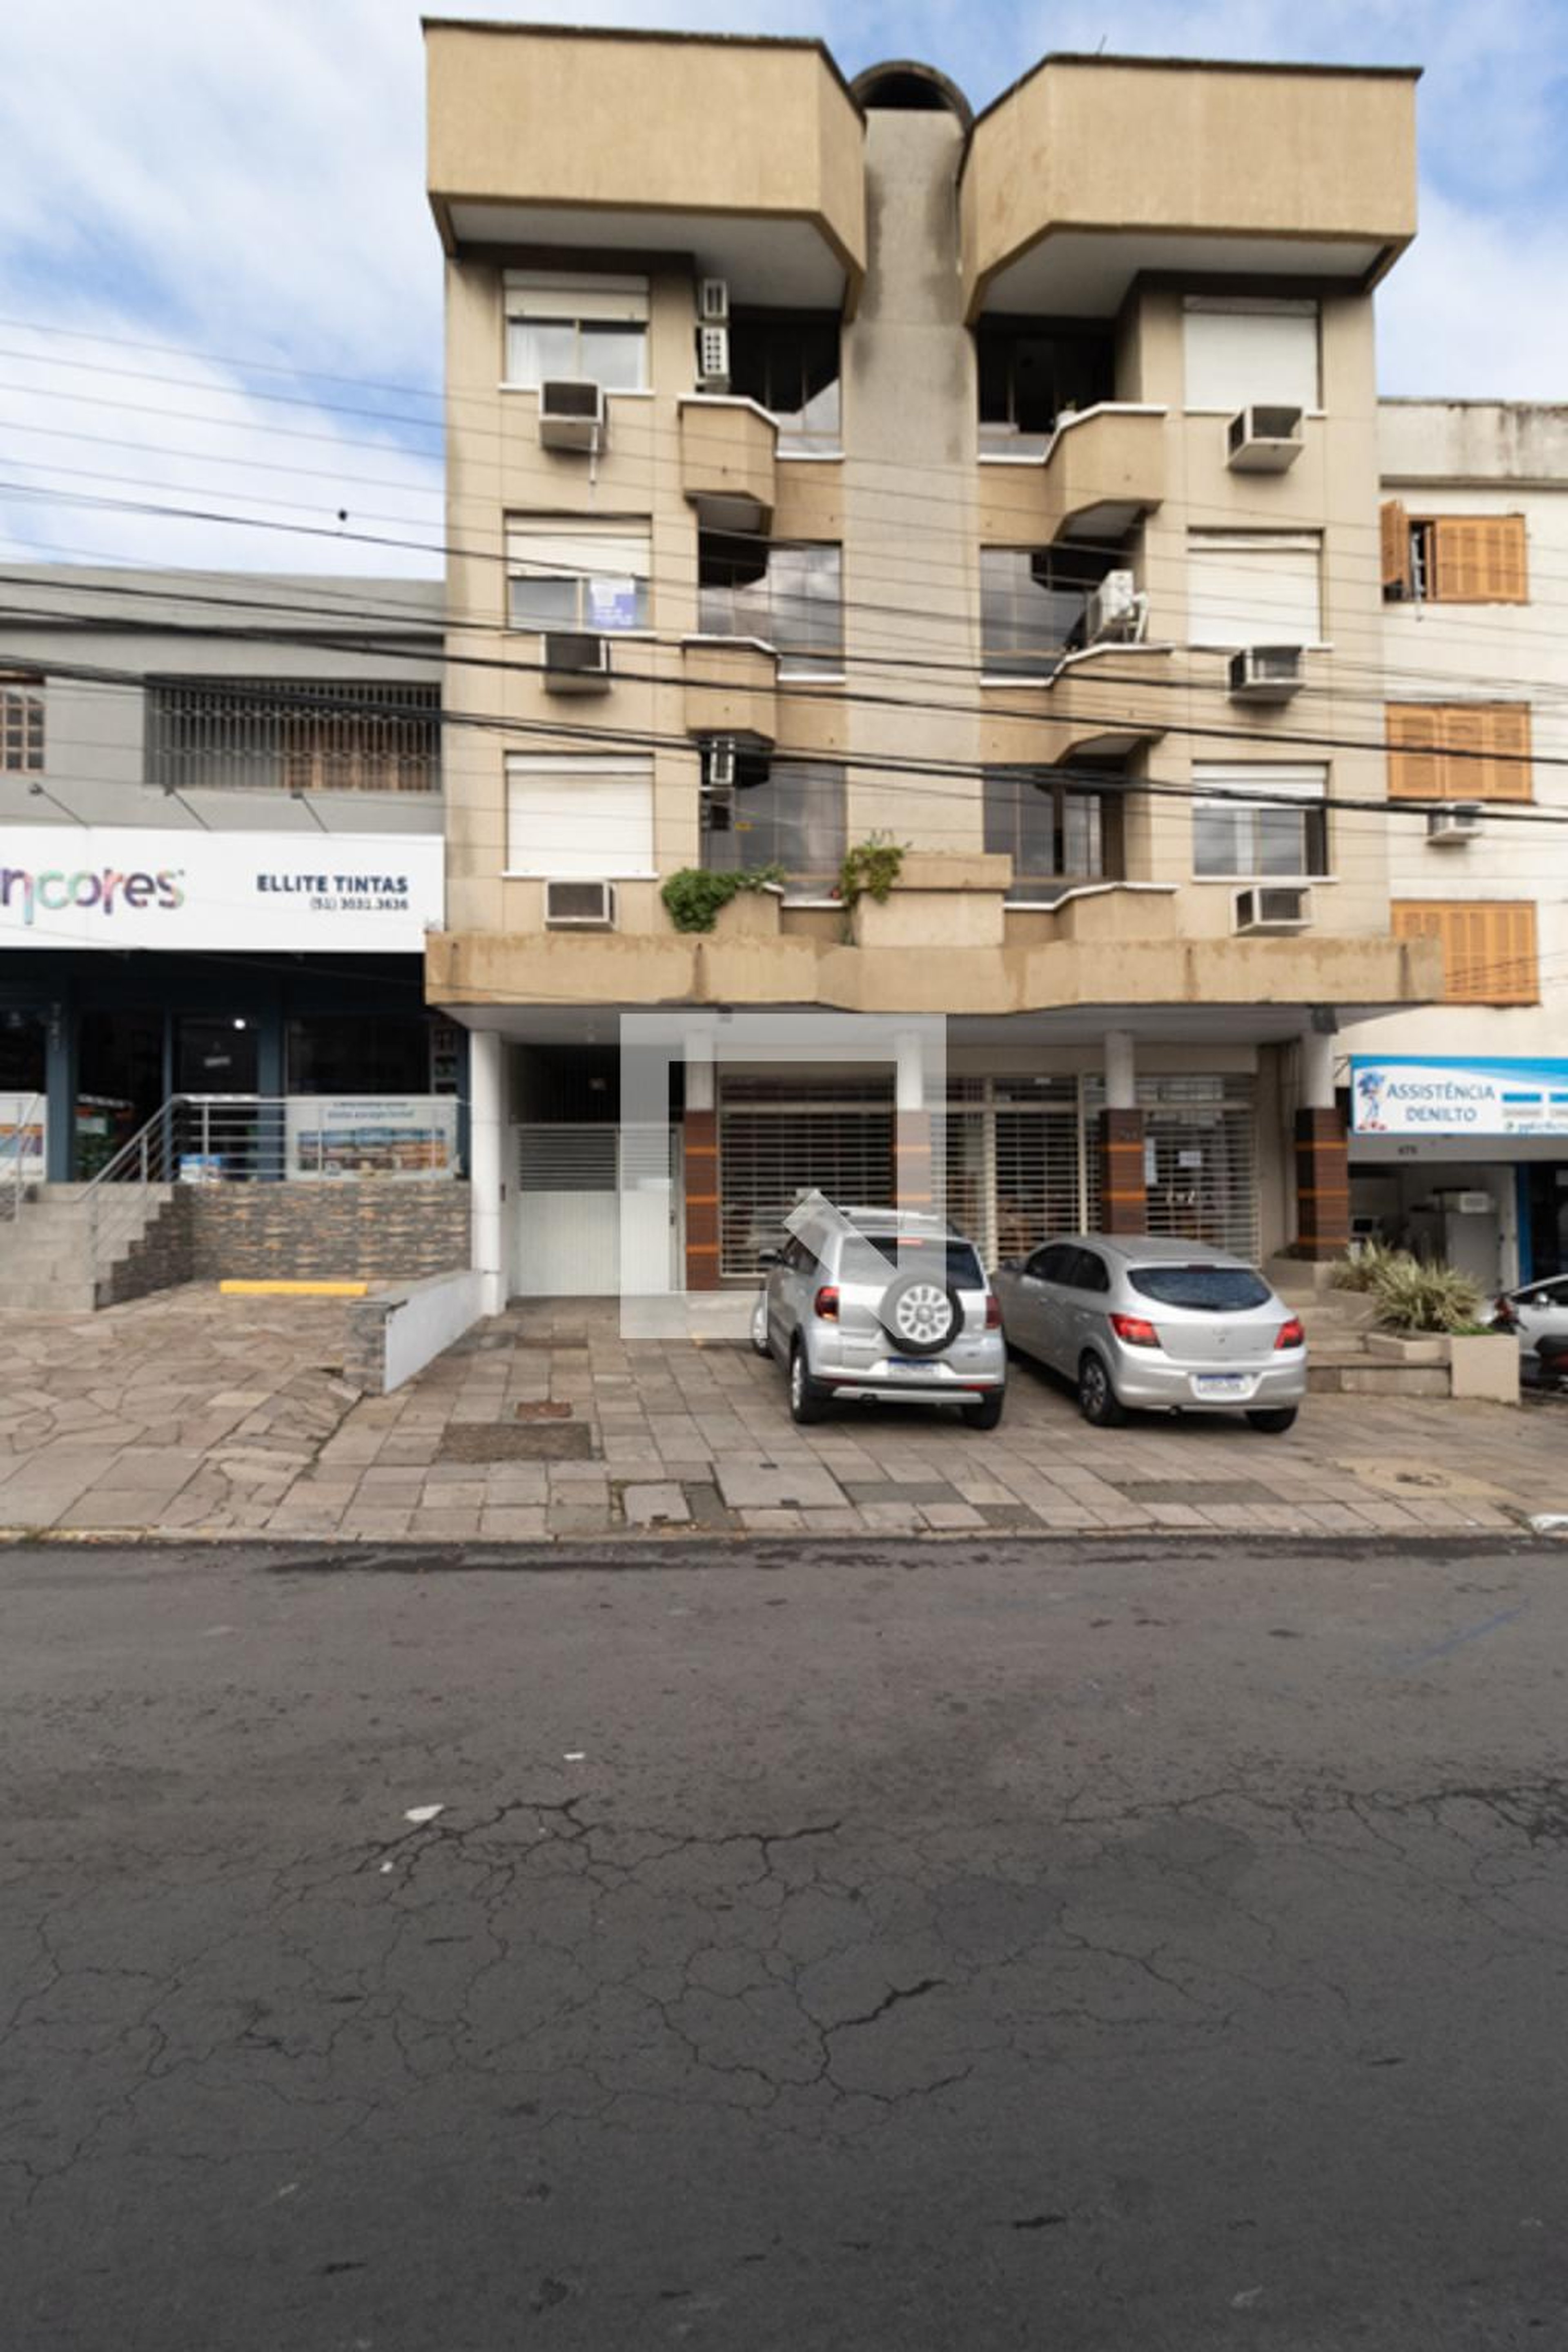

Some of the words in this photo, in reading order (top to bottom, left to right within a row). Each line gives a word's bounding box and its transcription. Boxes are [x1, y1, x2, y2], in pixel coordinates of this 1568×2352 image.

[257, 875, 328, 892] ELLITE
[334, 875, 408, 893] TINTAS
[310, 898, 337, 911] (51)
[1387, 1082, 1495, 1100] ASSISTÊNCIA
[1405, 1106, 1477, 1122] DENILTO
